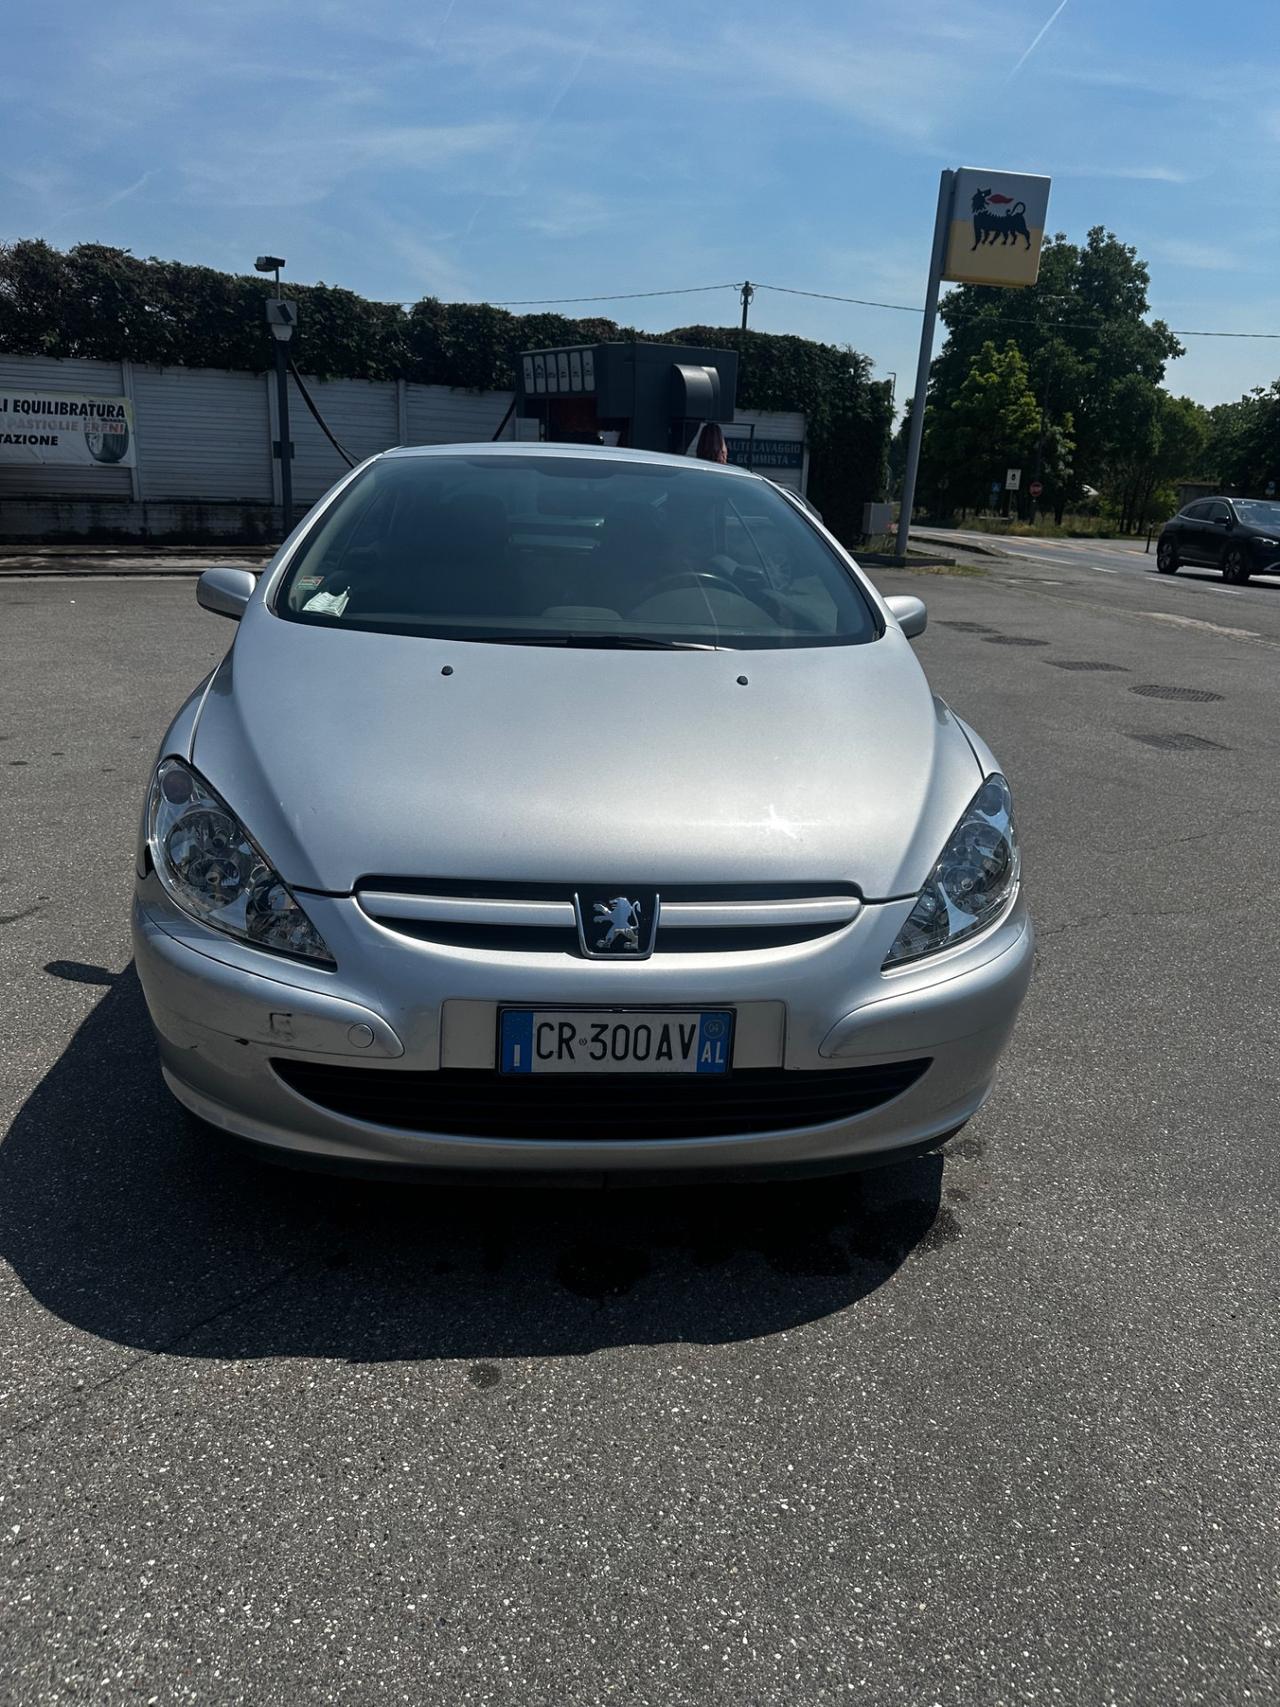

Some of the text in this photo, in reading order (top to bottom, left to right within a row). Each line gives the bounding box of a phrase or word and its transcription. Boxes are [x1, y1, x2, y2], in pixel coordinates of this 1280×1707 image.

[0, 399, 125, 418] I EQUILIBRATURA
[83, 421, 124, 433] FRENI
[701, 1041, 724, 1063] AL
